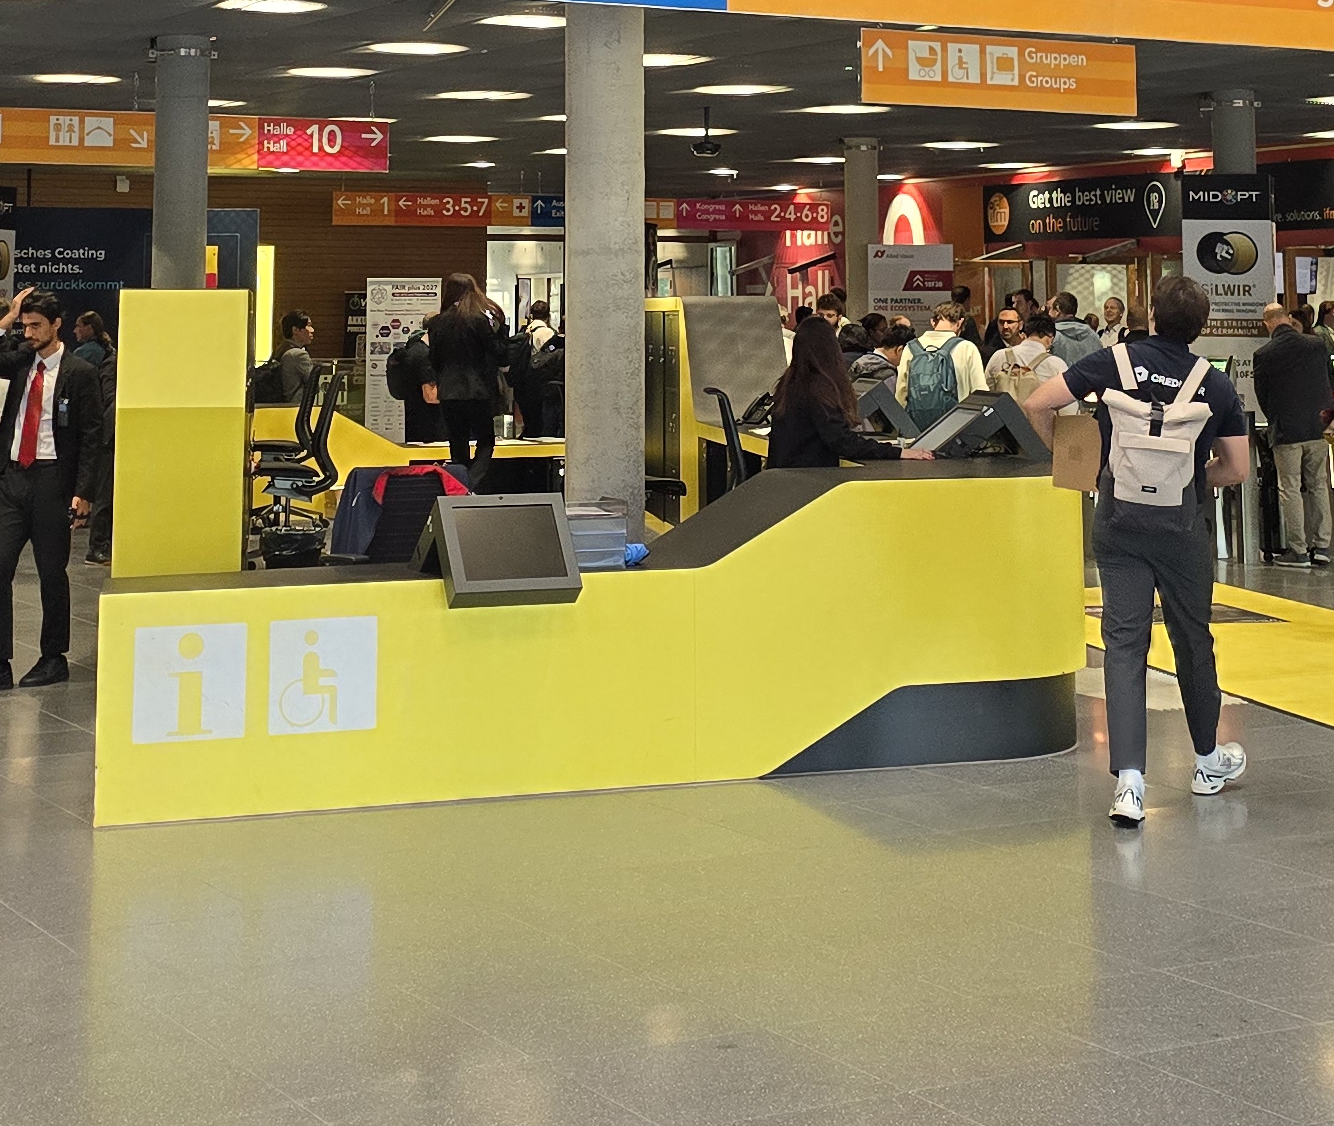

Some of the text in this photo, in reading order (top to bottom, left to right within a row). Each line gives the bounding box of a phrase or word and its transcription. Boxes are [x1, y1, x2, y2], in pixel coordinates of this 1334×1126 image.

[1025, 48, 1087, 70] Gruppen
[1025, 72, 1077, 93] Groups
[306, 125, 342, 154] 10
[263, 140, 287, 153] Hall
[417, 196, 439, 205] Hallen
[1029, 188, 1050, 209] Get
[1052, 188, 1071, 207] the
[1075, 186, 1101, 205] best
[1104, 185, 1135, 203] view
[417, 207, 434, 216] Halls
[696, 202, 726, 210] Kongress
[696, 212, 726, 221] Congress
[1030, 213, 1100, 234] on future
[55, 247, 105, 260] Coating
[40, 262, 83, 273] nichts.
